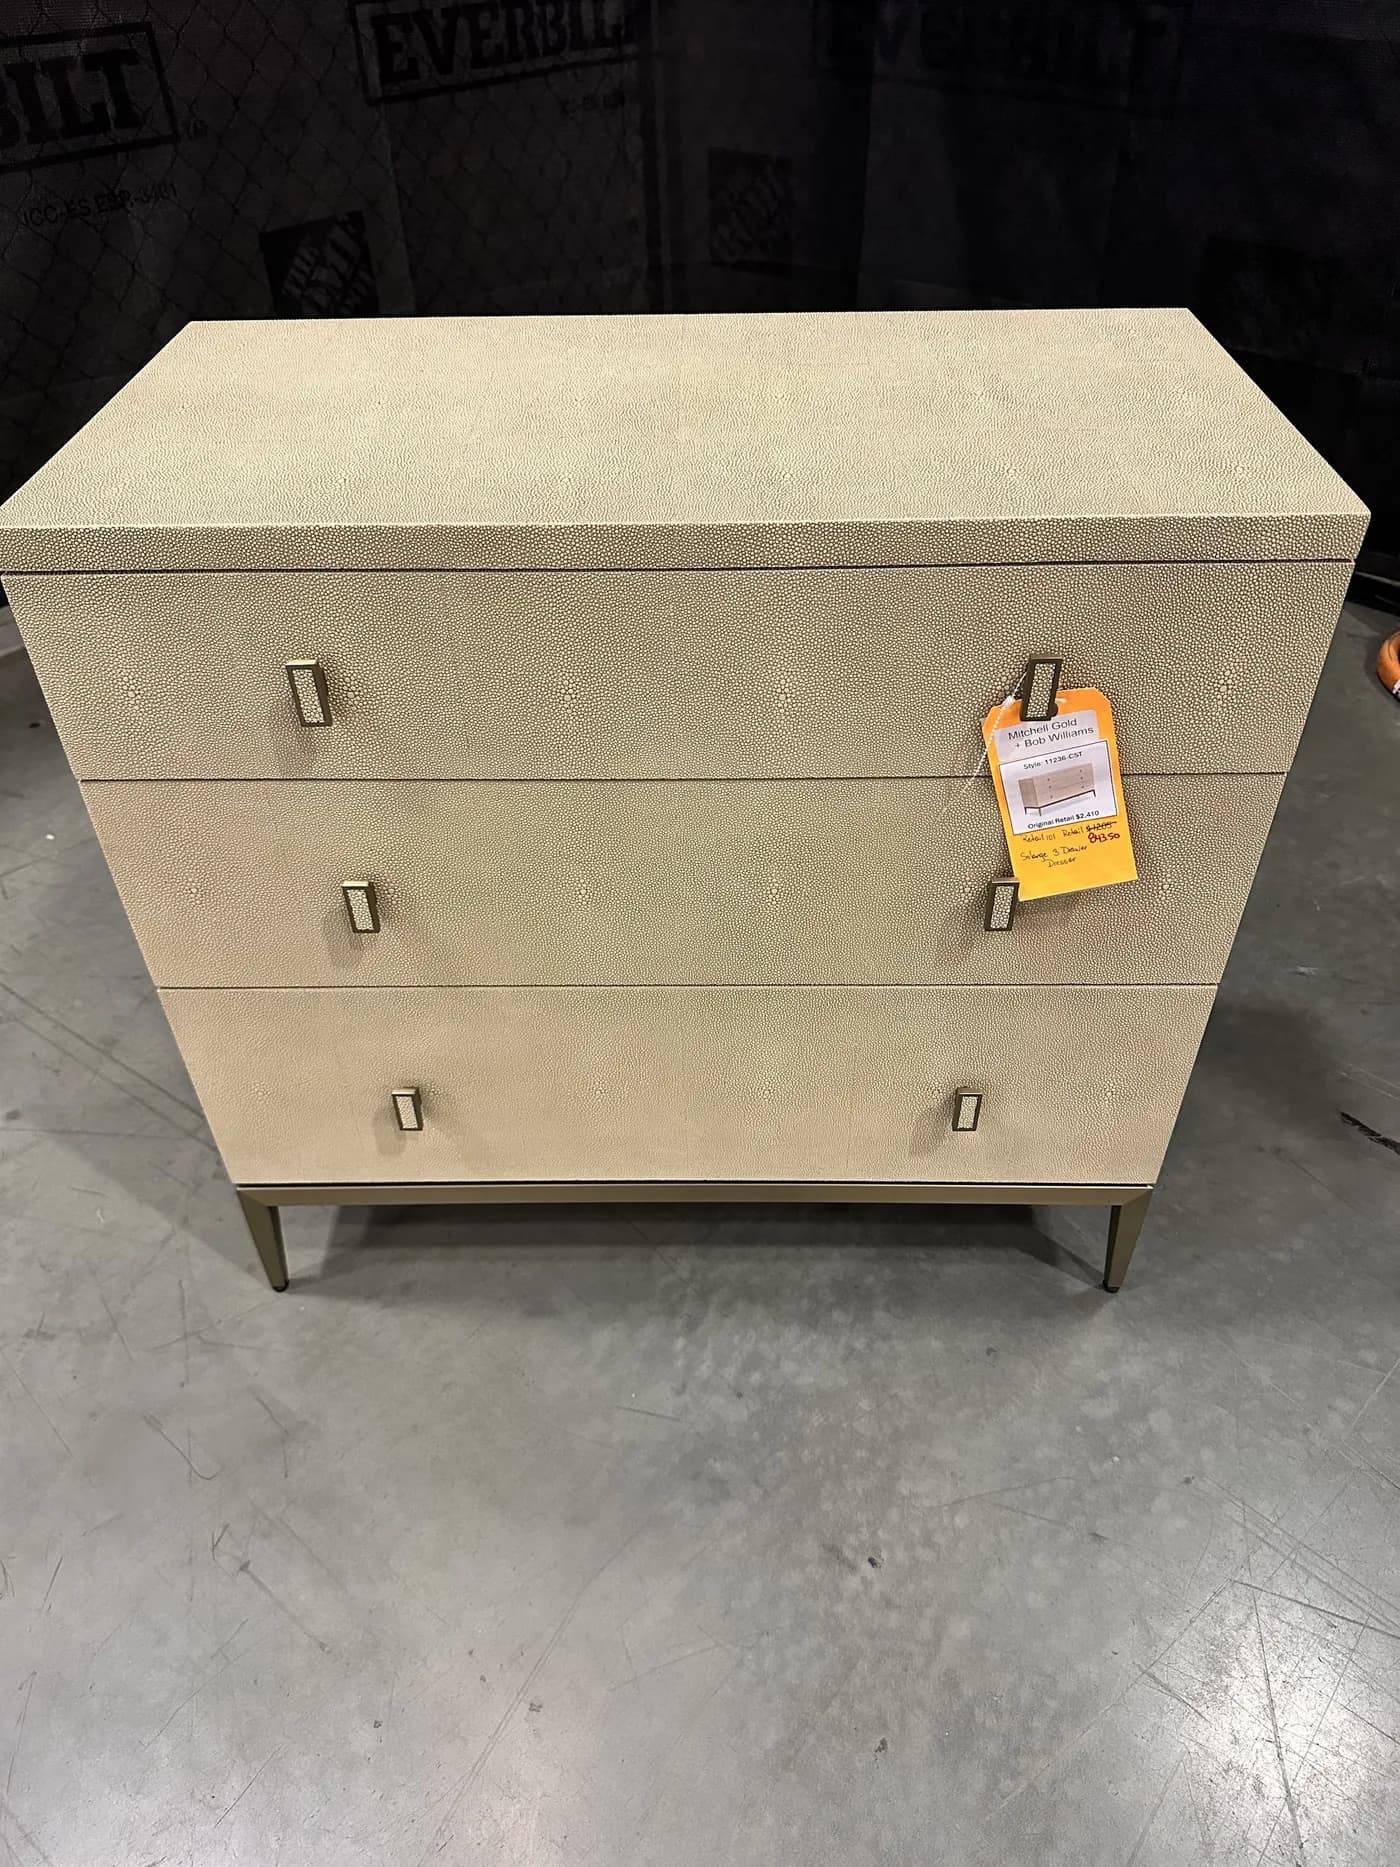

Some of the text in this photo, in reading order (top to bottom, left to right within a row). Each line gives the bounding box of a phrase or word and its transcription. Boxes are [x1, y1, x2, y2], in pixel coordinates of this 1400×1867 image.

[1008, 718, 1078, 741] Mitchell Gold
[1024, 737, 1046, 748] Bob
[1048, 727, 1094, 743] Williams
[1027, 810, 1100, 830] Original Retail $2,410
[1061, 826, 1085, 837] Retail
[1052, 848, 1059, 856] 3
